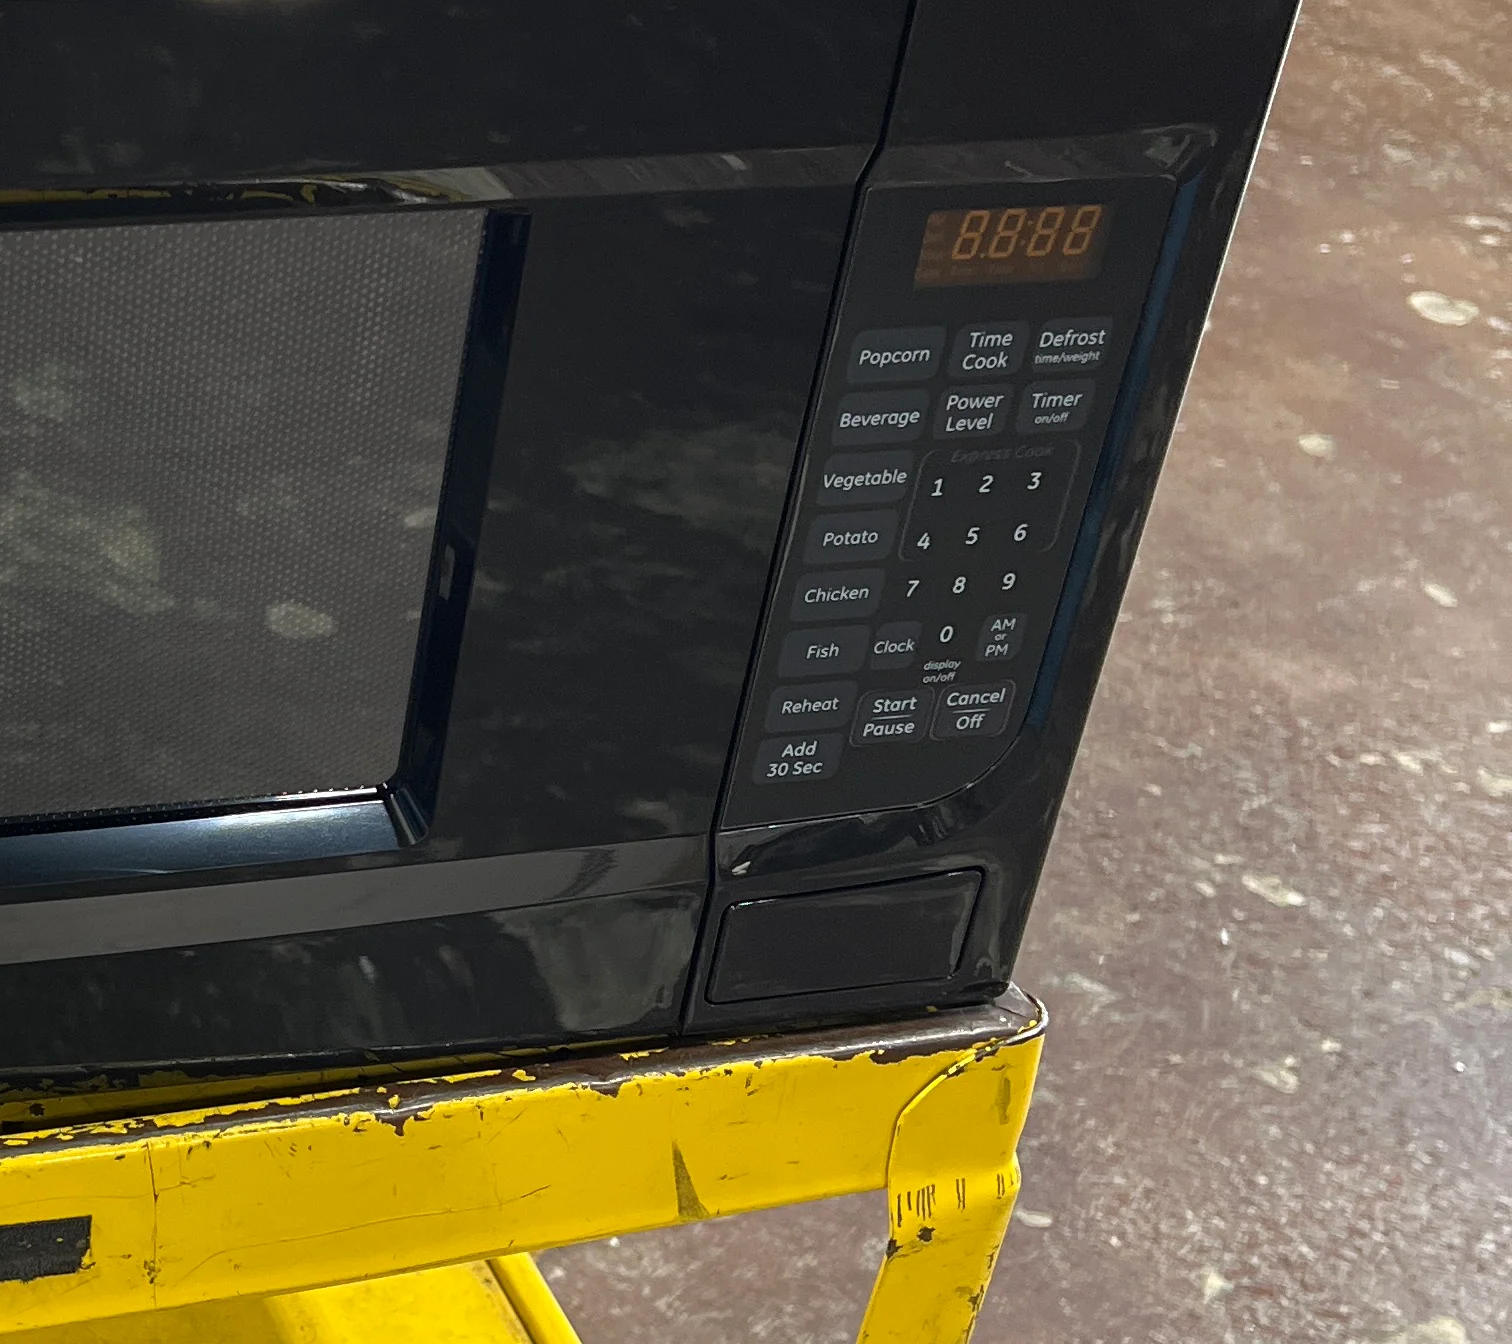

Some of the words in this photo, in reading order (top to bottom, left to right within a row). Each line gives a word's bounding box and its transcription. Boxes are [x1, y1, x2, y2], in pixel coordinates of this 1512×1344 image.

[970, 331, 1013, 348] Time
[1039, 328, 1106, 348] Defrost
[859, 349, 930, 368] Popcorn
[962, 351, 1009, 370] Cook
[1034, 350, 1101, 364] time/weight
[946, 394, 1005, 411] Power
[1032, 392, 1083, 409] Timer
[839, 411, 920, 428] Beverage
[945, 412, 994, 432] Level
[1034, 411, 1069, 425] on/off
[823, 468, 908, 491] Vegetable
[931, 478, 943, 497] 1
[978, 475, 994, 493] 2
[1027, 471, 1042, 490] 3
[822, 530, 879, 547] Potato
[916, 532, 930, 550] 4
[965, 527, 980, 545] 5
[1013, 523, 1028, 542] 6
[906, 579, 920, 598] 7
[952, 576, 967, 594] 8
[1001, 572, 1016, 590] 9
[804, 586, 870, 603] Chicken
[990, 618, 1017, 632] AM
[939, 625, 954, 643] 0
[994, 633, 1007, 642] or
[806, 642, 840, 659] Fish
[873, 638, 915, 654] Clock
[984, 643, 1009, 657] PM
[923, 659, 962, 672] display
[922, 671, 957, 684] on/off
[781, 697, 840, 714] Reheat
[872, 696, 918, 713] Start
[946, 687, 1006, 707] Cancel
[862, 719, 915, 737] Pause
[954, 713, 986, 730] Off
[781, 740, 818, 758] Add
[766, 762, 789, 777] 30
[792, 761, 823, 775] Sec
